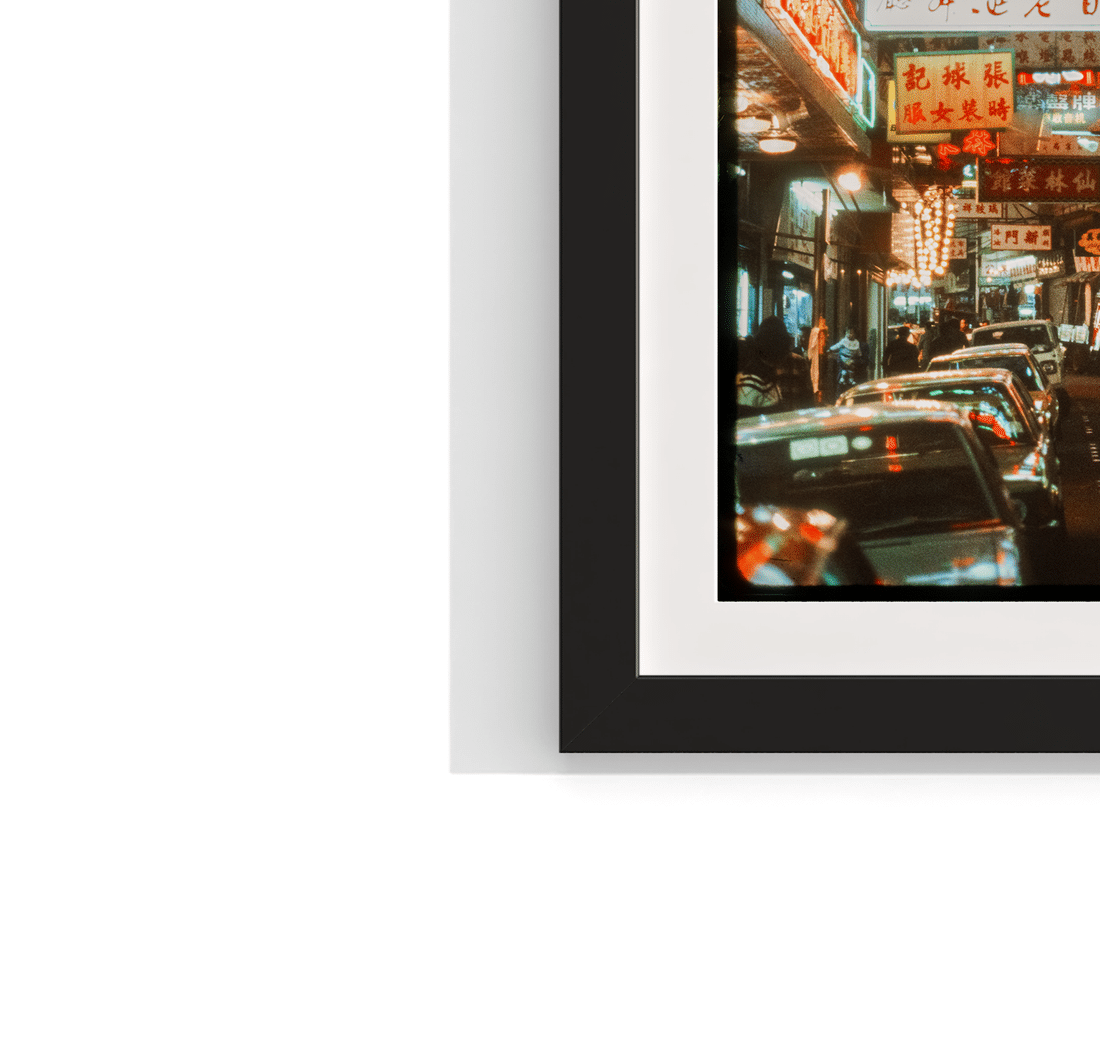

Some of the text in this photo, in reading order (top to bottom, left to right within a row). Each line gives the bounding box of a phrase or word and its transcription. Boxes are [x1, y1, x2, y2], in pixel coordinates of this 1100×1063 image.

[902, 61, 1010, 92] 張球記
[903, 98, 1011, 125] 時裝女服
